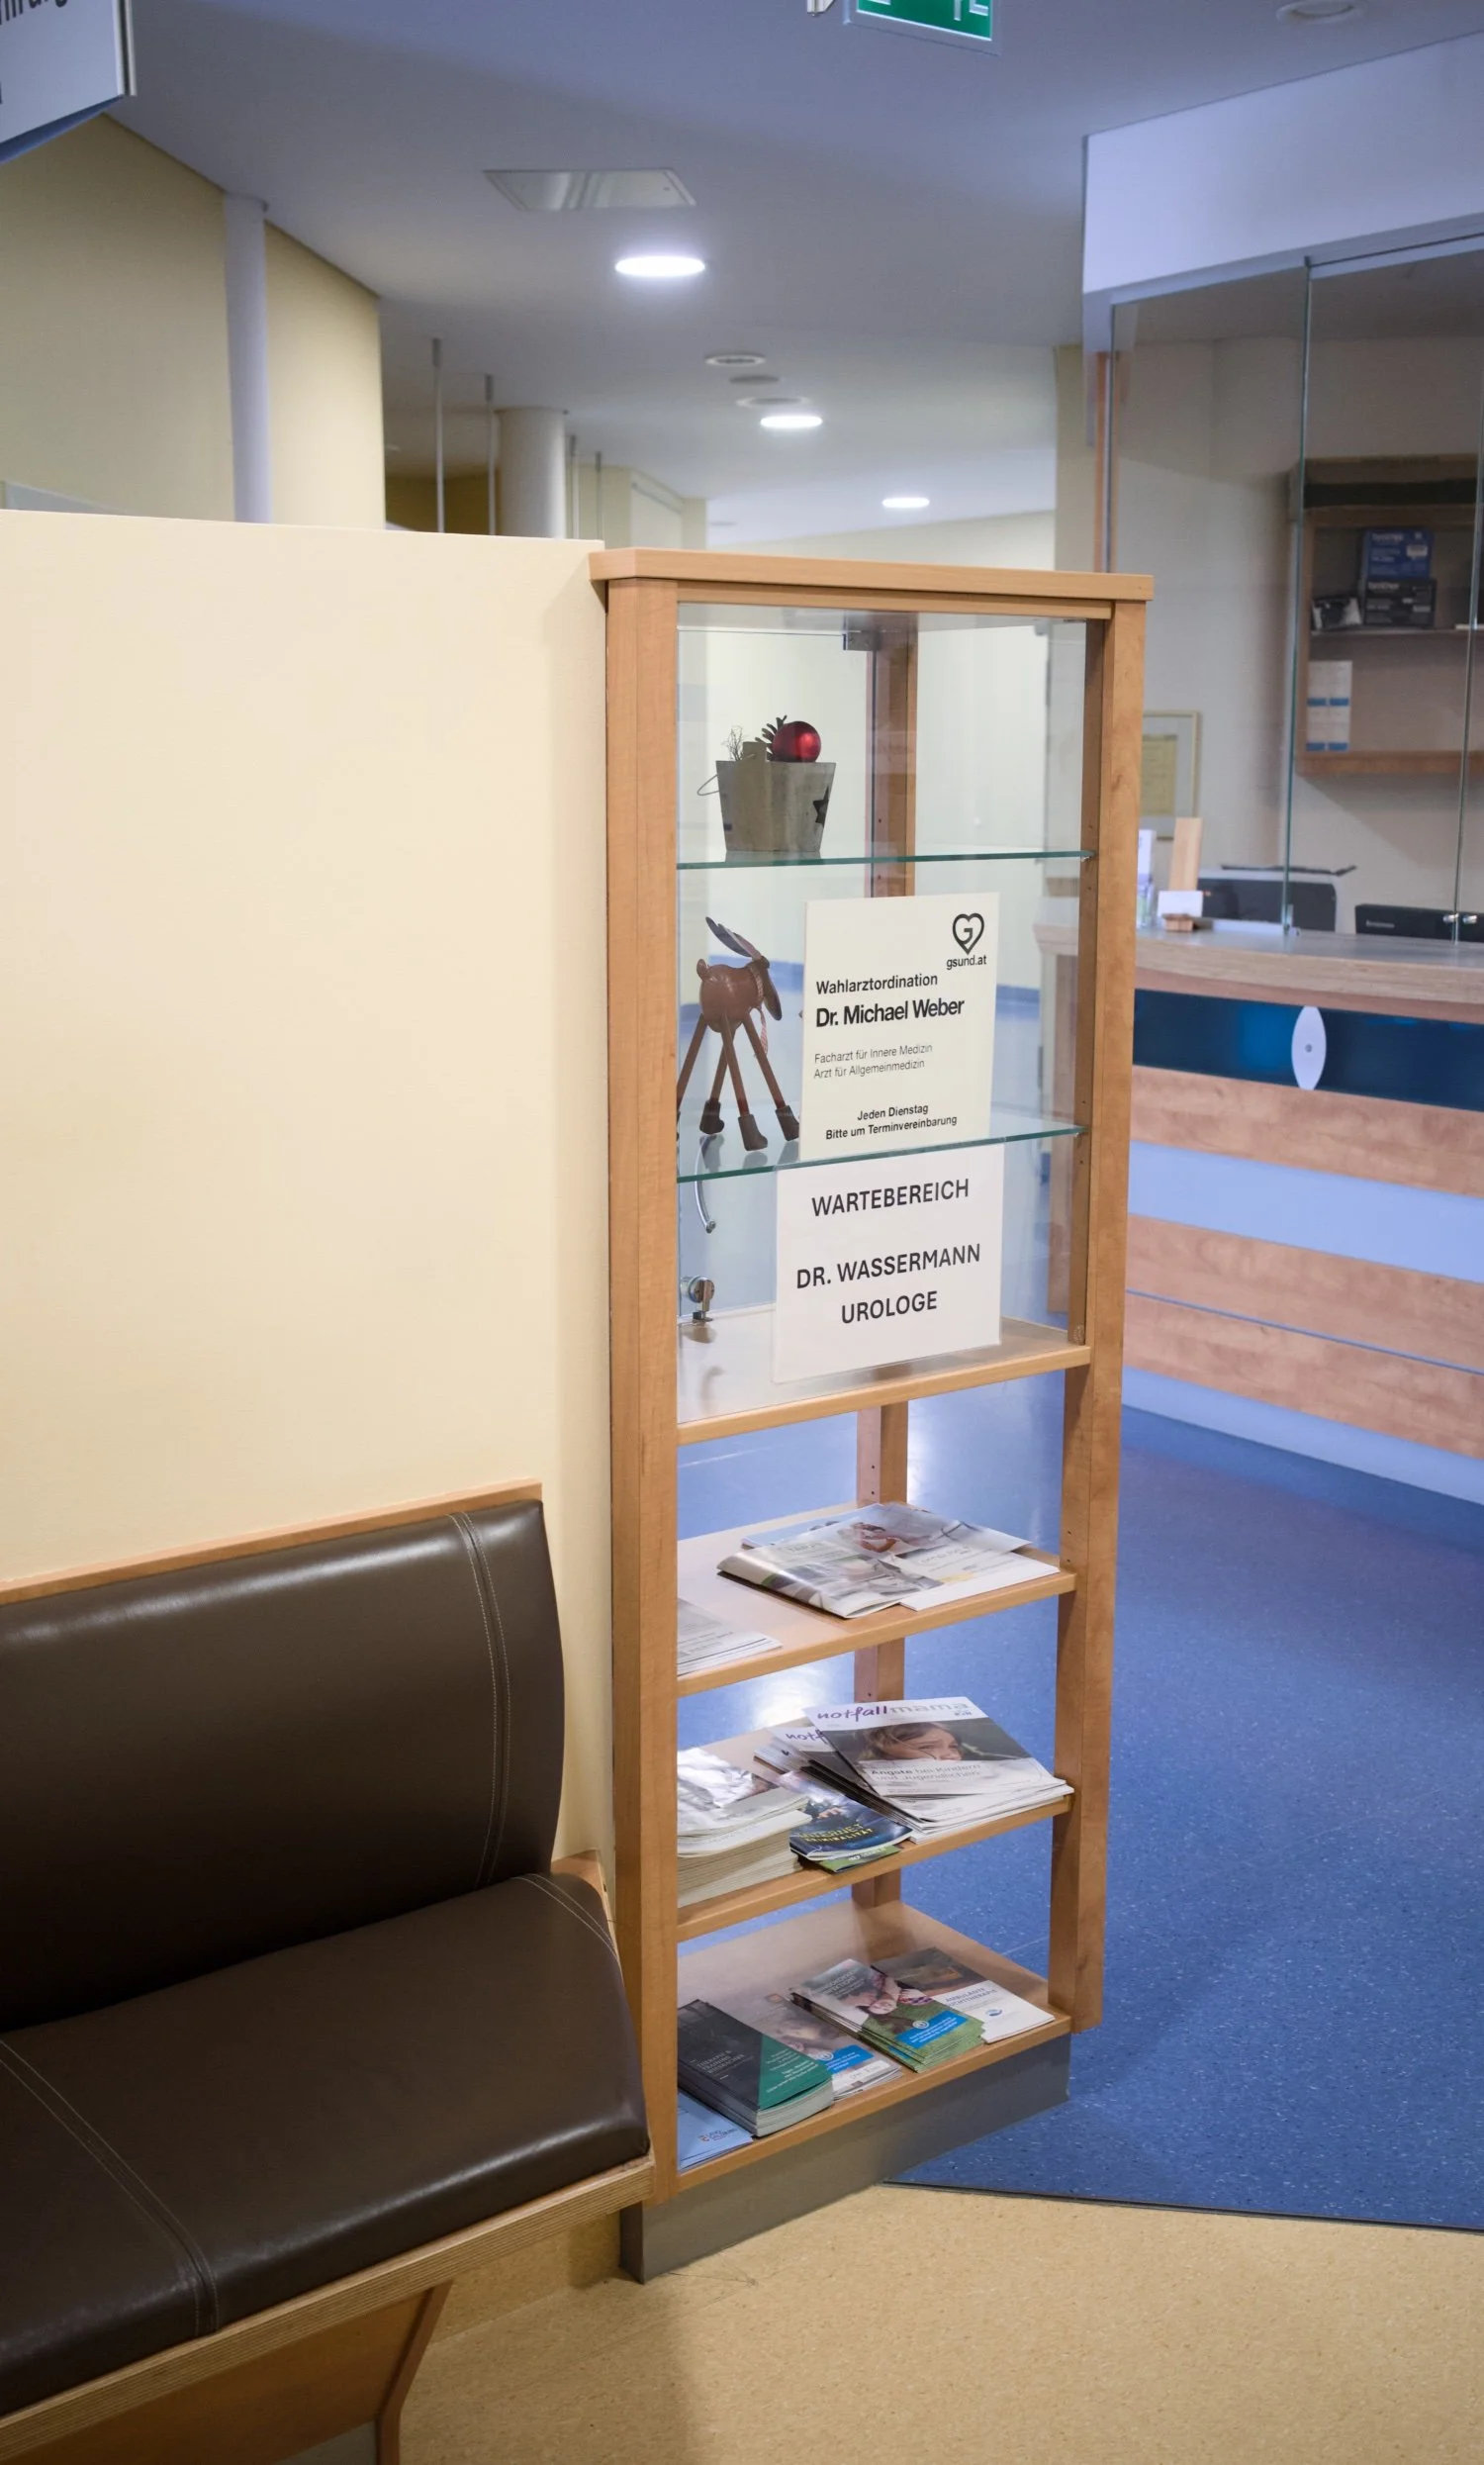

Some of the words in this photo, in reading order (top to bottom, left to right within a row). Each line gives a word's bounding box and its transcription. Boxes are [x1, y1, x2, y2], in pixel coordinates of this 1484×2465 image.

[946, 954, 986, 970] gsund.at
[816, 974, 938, 995] Wahlarztordination
[816, 1007, 838, 1027] Dr.
[844, 1000, 908, 1025] Michael
[912, 997, 965, 1018] Weber
[814, 1050, 854, 1064] Facharzt
[856, 1049, 868, 1061] für
[870, 1046, 897, 1059] Innere
[899, 1043, 933, 1056] Medizin
[813, 1066, 832, 1080] Arzt
[834, 1065, 847, 1077] für
[849, 1059, 925, 1078] Allgemeinmedizin
[857, 1107, 886, 1121] Jeden
[888, 1103, 929, 1117] Dienstag
[825, 1128, 848, 1140] Bitte
[851, 1126, 866, 1137] um
[869, 1115, 958, 1135] Terminvereinbarung
[811, 1178, 970, 1217] WARTEBEREICH
[796, 1267, 832, 1288] DR.
[837, 1243, 980, 1282] WASSERMANN
[841, 1290, 938, 1324] UROLOGE
